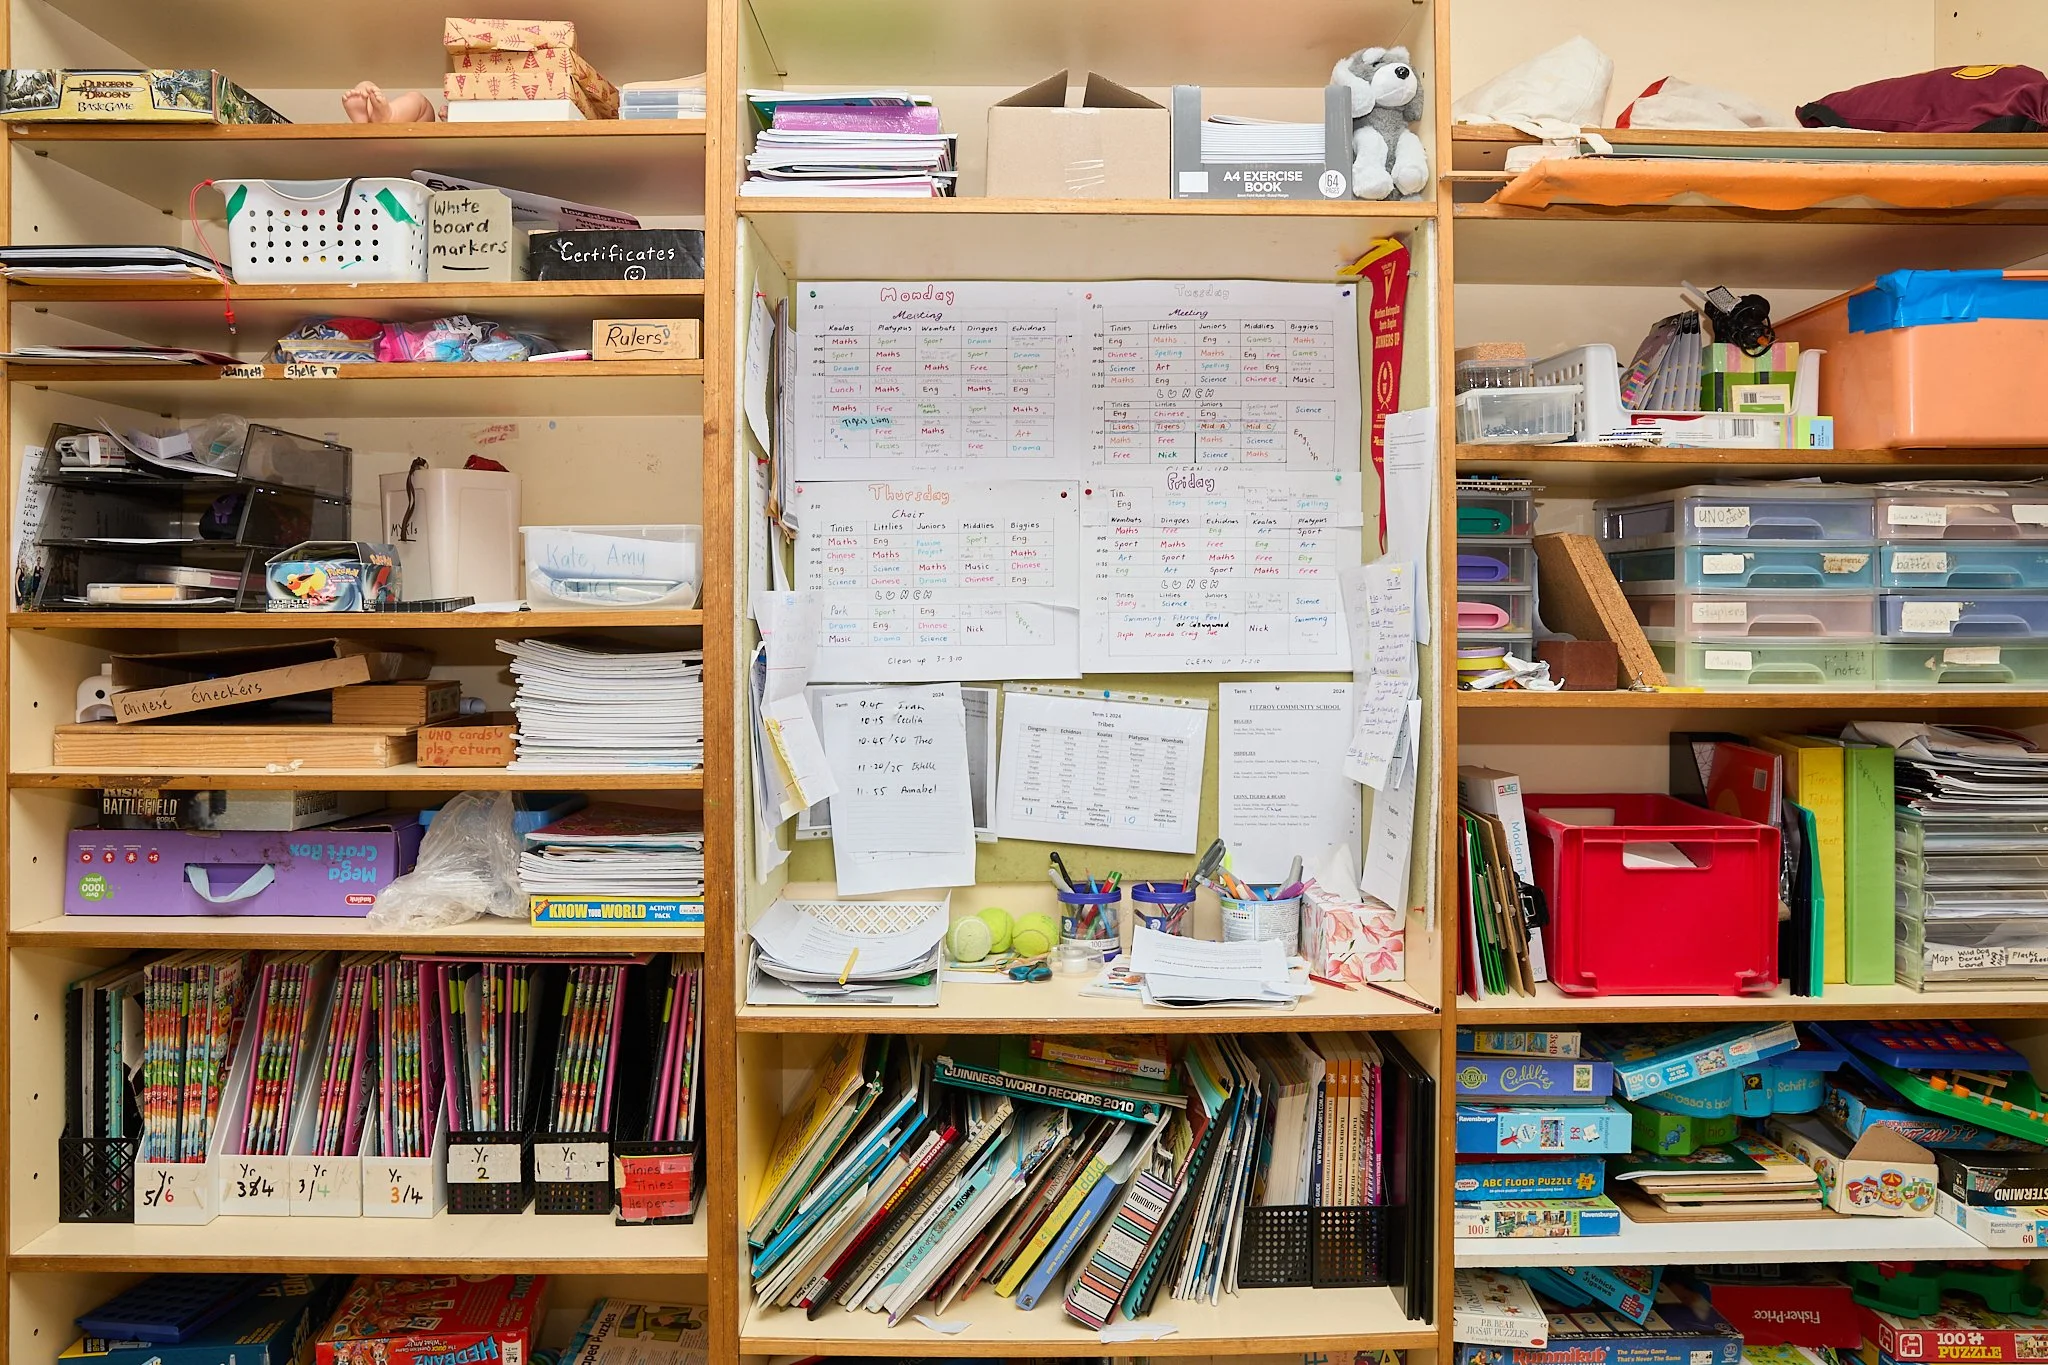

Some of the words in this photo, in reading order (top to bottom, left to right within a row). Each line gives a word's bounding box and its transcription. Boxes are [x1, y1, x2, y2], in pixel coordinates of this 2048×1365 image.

[1223, 171, 1240, 181] A4
[1244, 171, 1302, 181] EXERCISE
[1327, 174, 1338, 187] 64
[1245, 182, 1281, 192] BOOK
[433, 198, 480, 214] White
[432, 219, 489, 234] board
[432, 240, 508, 256] markers
[560, 241, 675, 262] Certificates
[880, 284, 955, 305] Monday
[831, 337, 858, 345] Maths
[287, 364, 317, 377] Shelf
[876, 364, 893, 372] Free
[924, 363, 949, 371] Maths
[1156, 363, 1170, 371] Art
[875, 385, 900, 393] Maths
[923, 386, 939, 395] Eng
[1167, 472, 1216, 492] Friday
[869, 484, 950, 505] Thursday
[892, 510, 925, 519] Choir
[1698, 510, 1725, 524] UNO
[830, 524, 854, 532] Tinies
[963, 522, 994, 530] Middlies
[828, 538, 857, 546] Maths
[606, 544, 646, 575] Amy
[872, 551, 900, 559] Maths
[1209, 553, 1235, 561] Maths
[919, 563, 947, 571] Maths
[966, 625, 984, 633] Nick
[1249, 624, 1269, 632] Nick
[123, 699, 172, 716] Chinese
[458, 731, 493, 740] cards
[449, 744, 502, 755] return
[103, 798, 178, 817] BATTLEFIELD
[1511, 821, 1524, 865] Modern
[290, 844, 326, 859] Box
[328, 844, 377, 859] Craft
[328, 860, 377, 883] Mega
[81, 883, 105, 893] 1000
[549, 904, 588, 919] KNOW
[601, 903, 646, 919] WORLD
[1932, 954, 1953, 965] Maps
[1500, 1066, 1554, 1090] Cuddlies
[944, 1066, 1004, 1087] GUINNESS
[1004, 1077, 1049, 1097] WORLD
[1048, 1086, 1102, 1106] RECORDS
[1103, 1096, 1135, 1113] 2010
[1778, 1078, 1806, 1092] Schiff
[477, 1168, 489, 1180] 2
[1482, 1179, 1503, 1188] ABC
[1505, 1178, 1535, 1186] FLOOR
[1538, 1177, 1572, 1186] PUZZLE
[1468, 1225, 1484, 1235] 100
[2022, 1235, 2034, 1243] 60
[1754, 1310, 1820, 1324] Fisher-Price
[1496, 1320, 1514, 1328] BEAR
[1466, 1326, 1492, 1335] JIGSAW
[1494, 1328, 1529, 1338] PUZZLES
[1937, 1333, 1966, 1344] 100
[1512, 1346, 1607, 1364] Rummikub
[1938, 1346, 2002, 1359] PUZZLE
